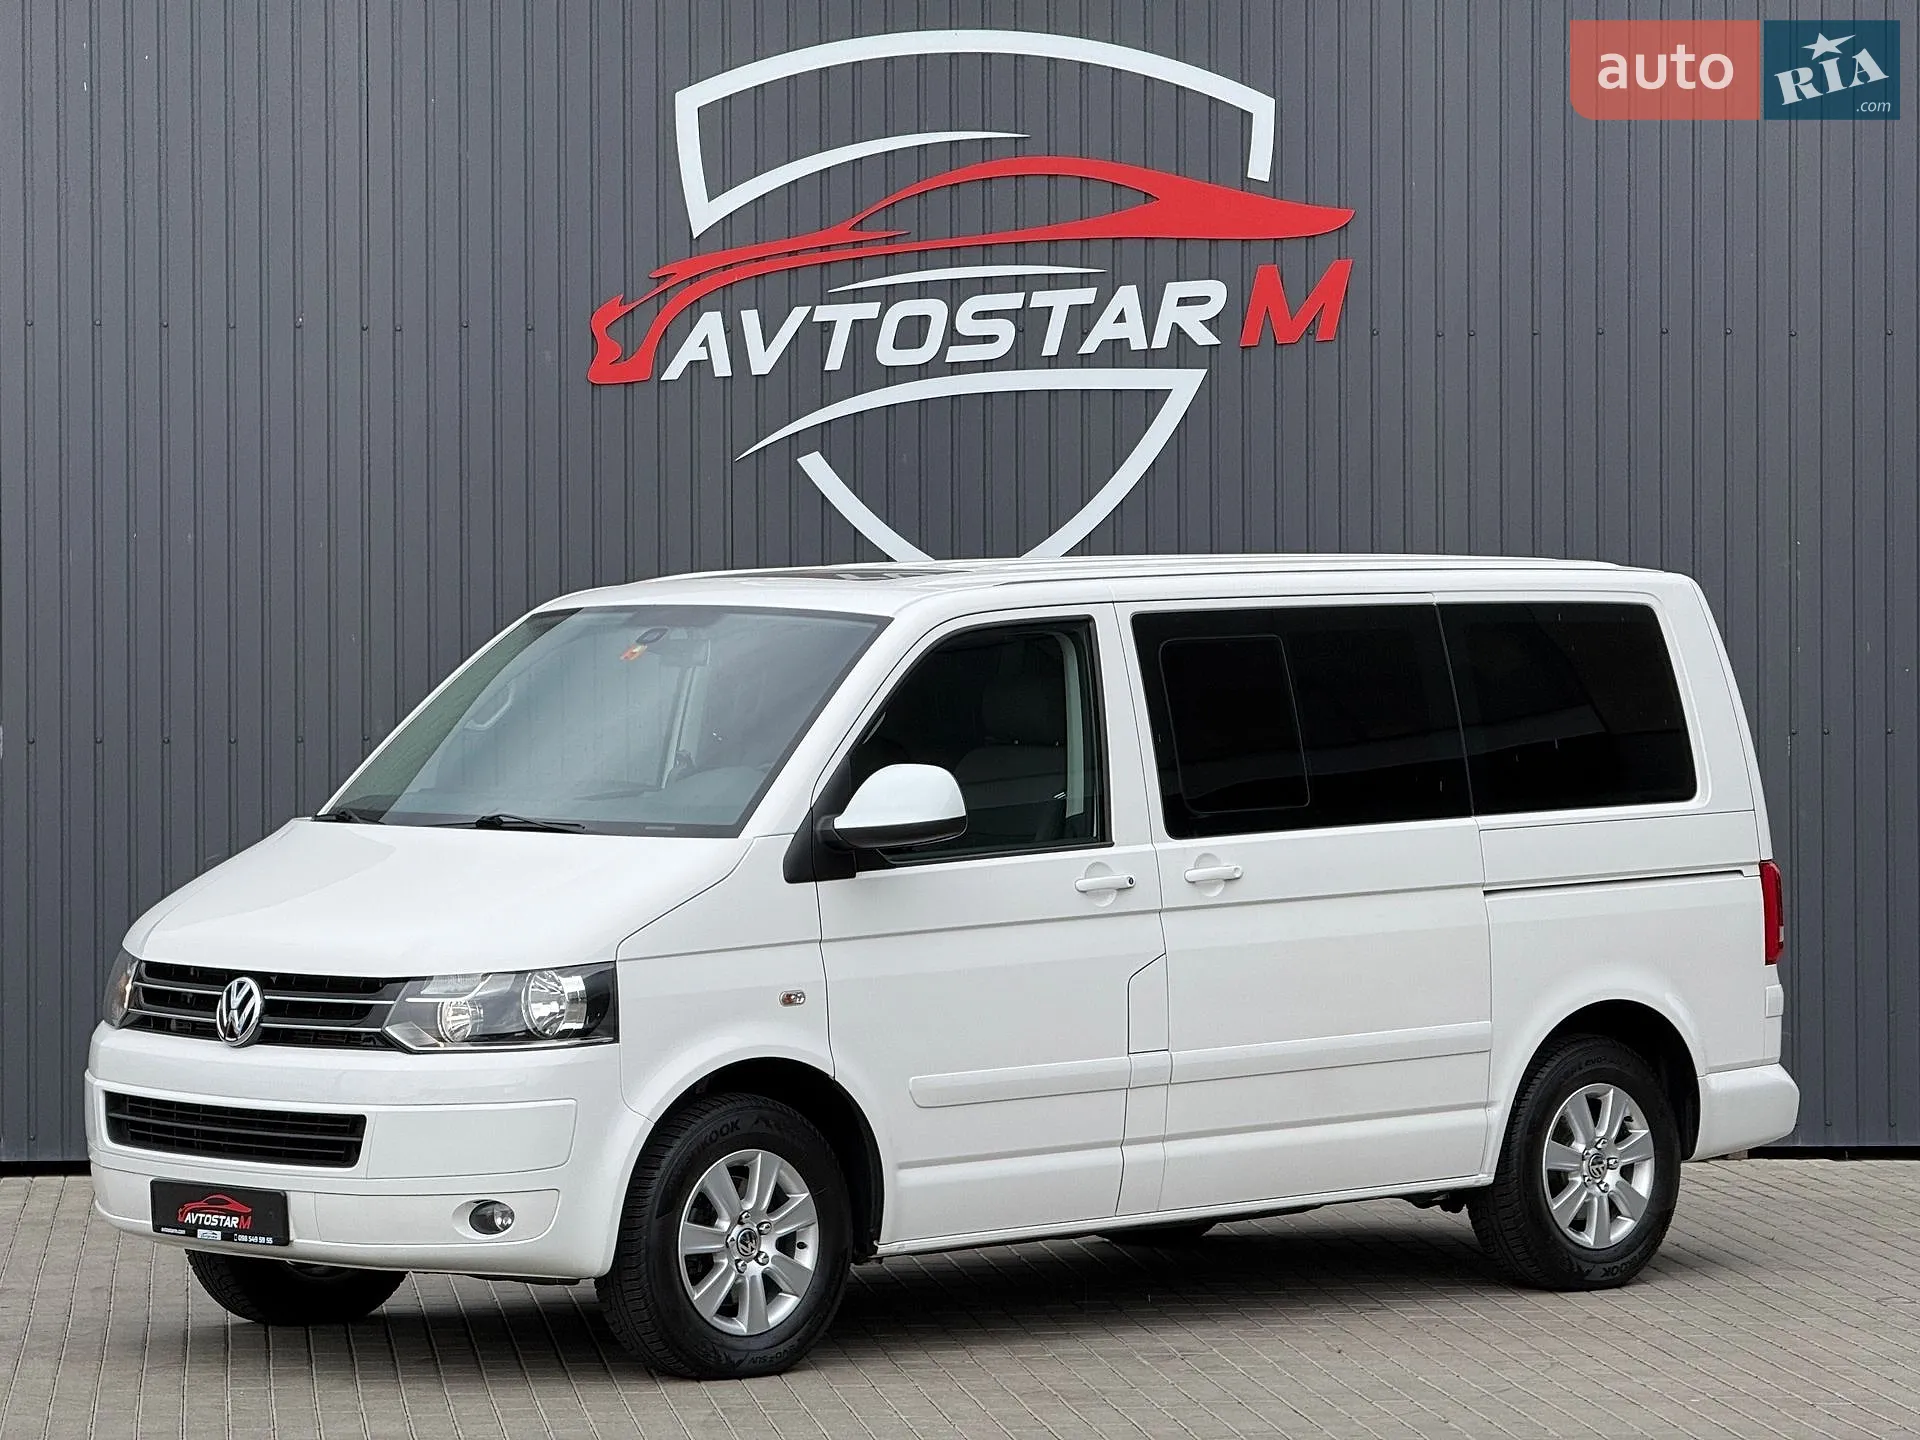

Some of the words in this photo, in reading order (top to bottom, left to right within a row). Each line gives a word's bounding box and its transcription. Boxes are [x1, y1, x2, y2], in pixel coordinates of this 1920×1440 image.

[660, 279, 1228, 381] AVTOSTAR
[1240, 259, 1353, 347] M
[184, 1212, 239, 1228] AVTOSTAR
[239, 1215, 252, 1230] M
